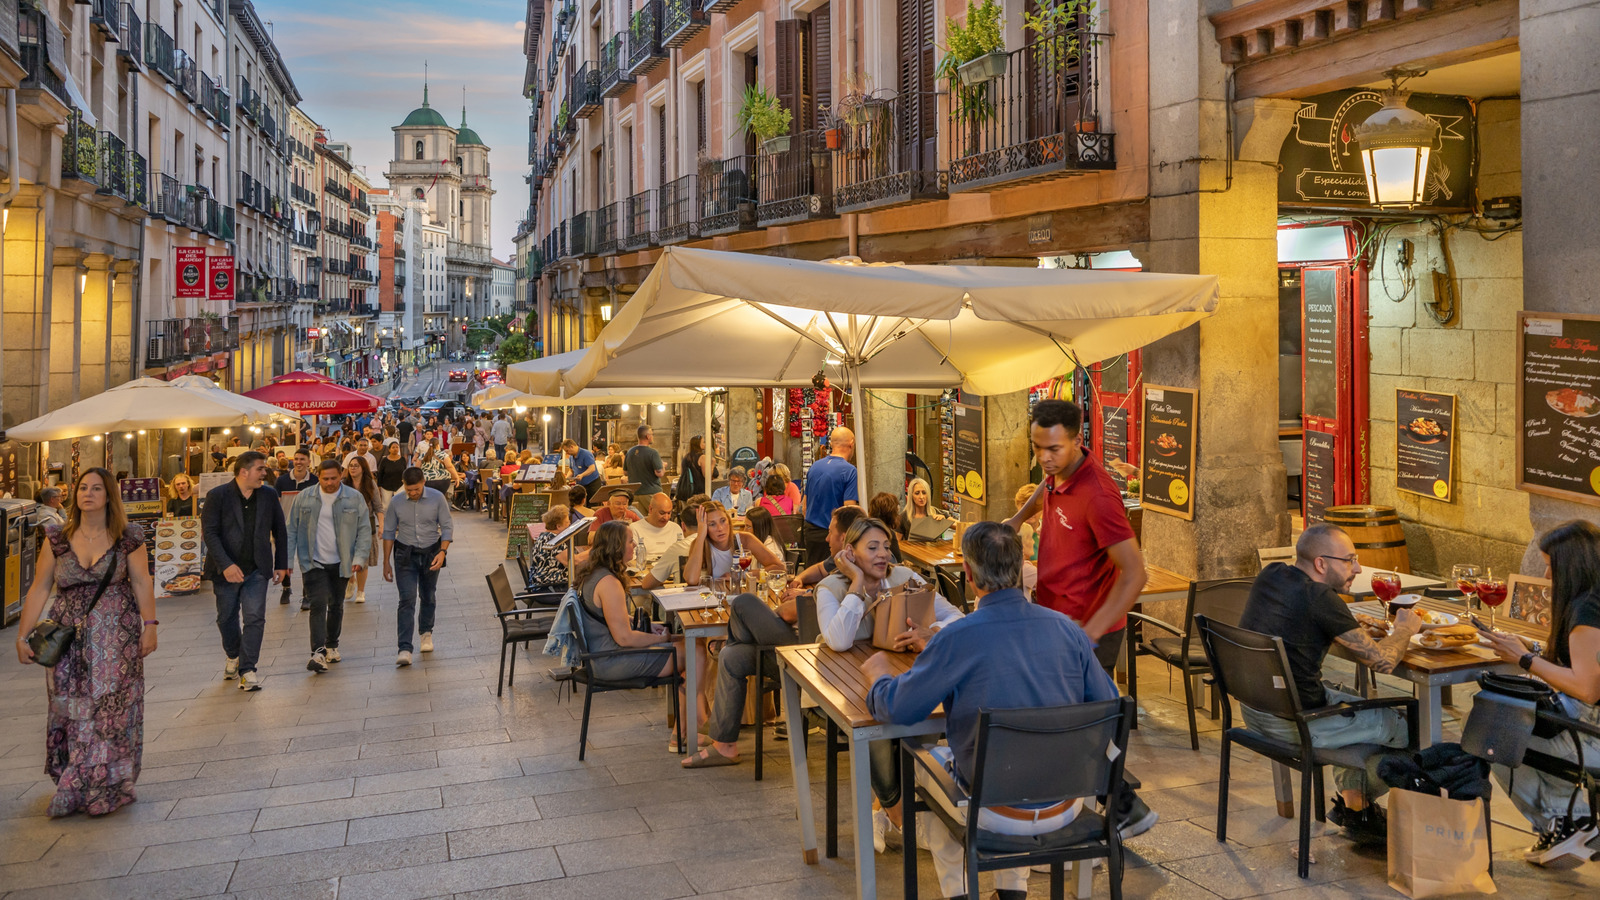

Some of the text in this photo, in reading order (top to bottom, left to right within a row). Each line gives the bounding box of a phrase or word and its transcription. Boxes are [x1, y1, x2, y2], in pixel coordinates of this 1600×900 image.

[1314, 175, 1369, 186] Especialida
[1324, 190, 1330, 198] y
[1308, 304, 1332, 312] PESCADOS
[301, 401, 337, 409] ABUELO
